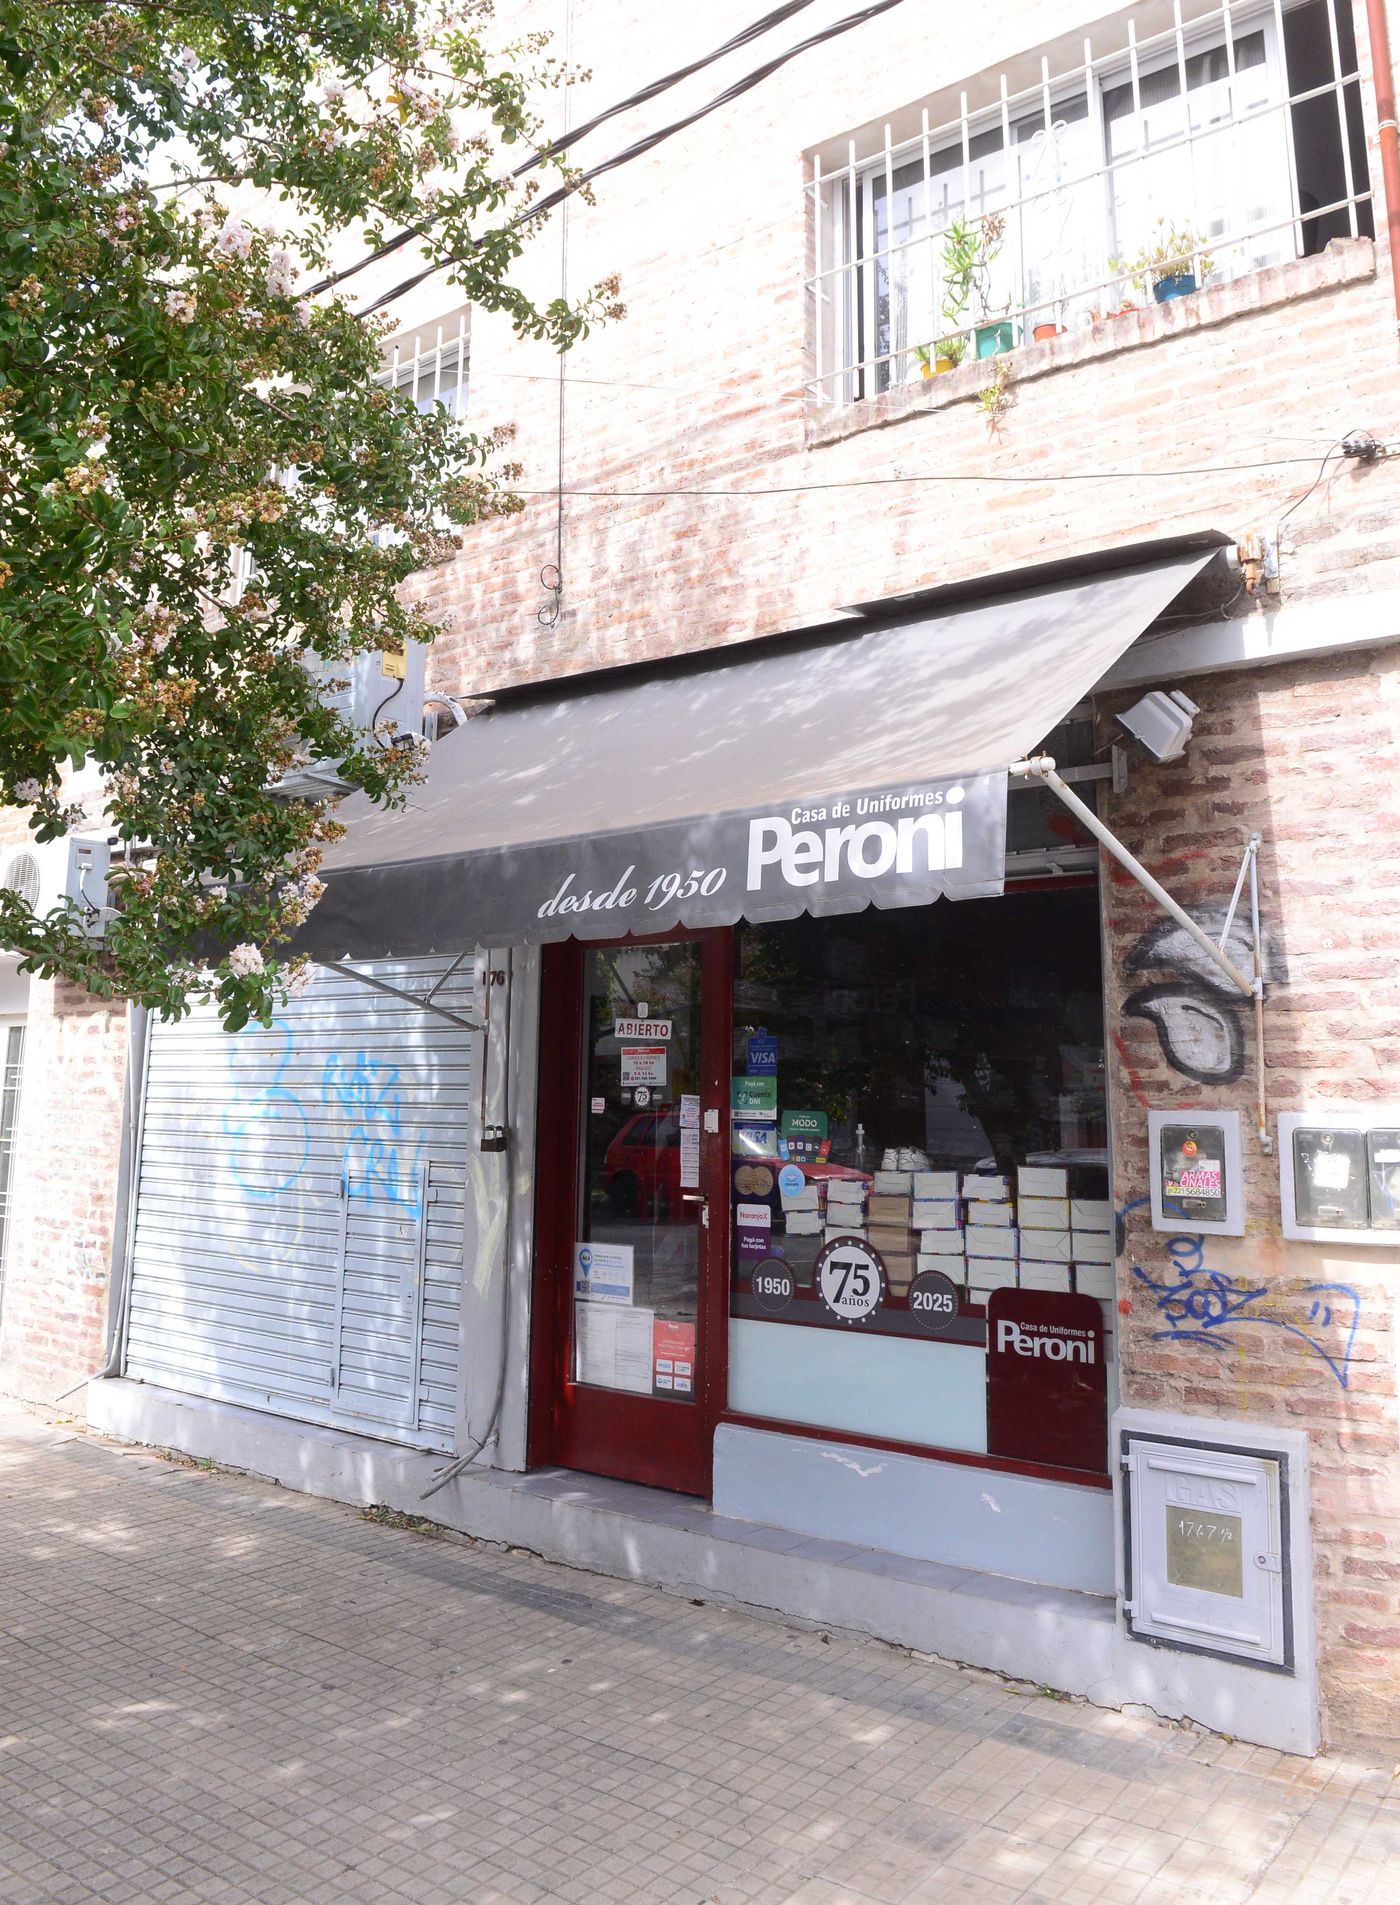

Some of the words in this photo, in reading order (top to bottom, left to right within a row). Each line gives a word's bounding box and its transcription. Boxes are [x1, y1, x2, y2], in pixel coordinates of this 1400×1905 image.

[791, 804, 828, 825] Casa
[831, 801, 850, 818] de
[857, 791, 943, 815] Uniformes
[747, 786, 965, 892] Peroni
[537, 864, 636, 920] desde
[646, 867, 727, 911] 1950
[618, 1022, 668, 1037] ABIERTO
[750, 1053, 775, 1063] VISA
[749, 1090, 771, 1098] Cuenta
[791, 1118, 818, 1128] MODO
[755, 1276, 791, 1297] 1950
[828, 1260, 872, 1305] 75
[841, 1294, 870, 1309] años
[912, 1291, 953, 1313] 2025
[1020, 1321, 1037, 1332] Casa
[1039, 1324, 1048, 1332] de
[1049, 1325, 1086, 1337] Uniformes
[997, 1319, 1095, 1364] Peroni
[1174, 1475, 1236, 1509] GAS
[1179, 1520, 1216, 1540] 1767
